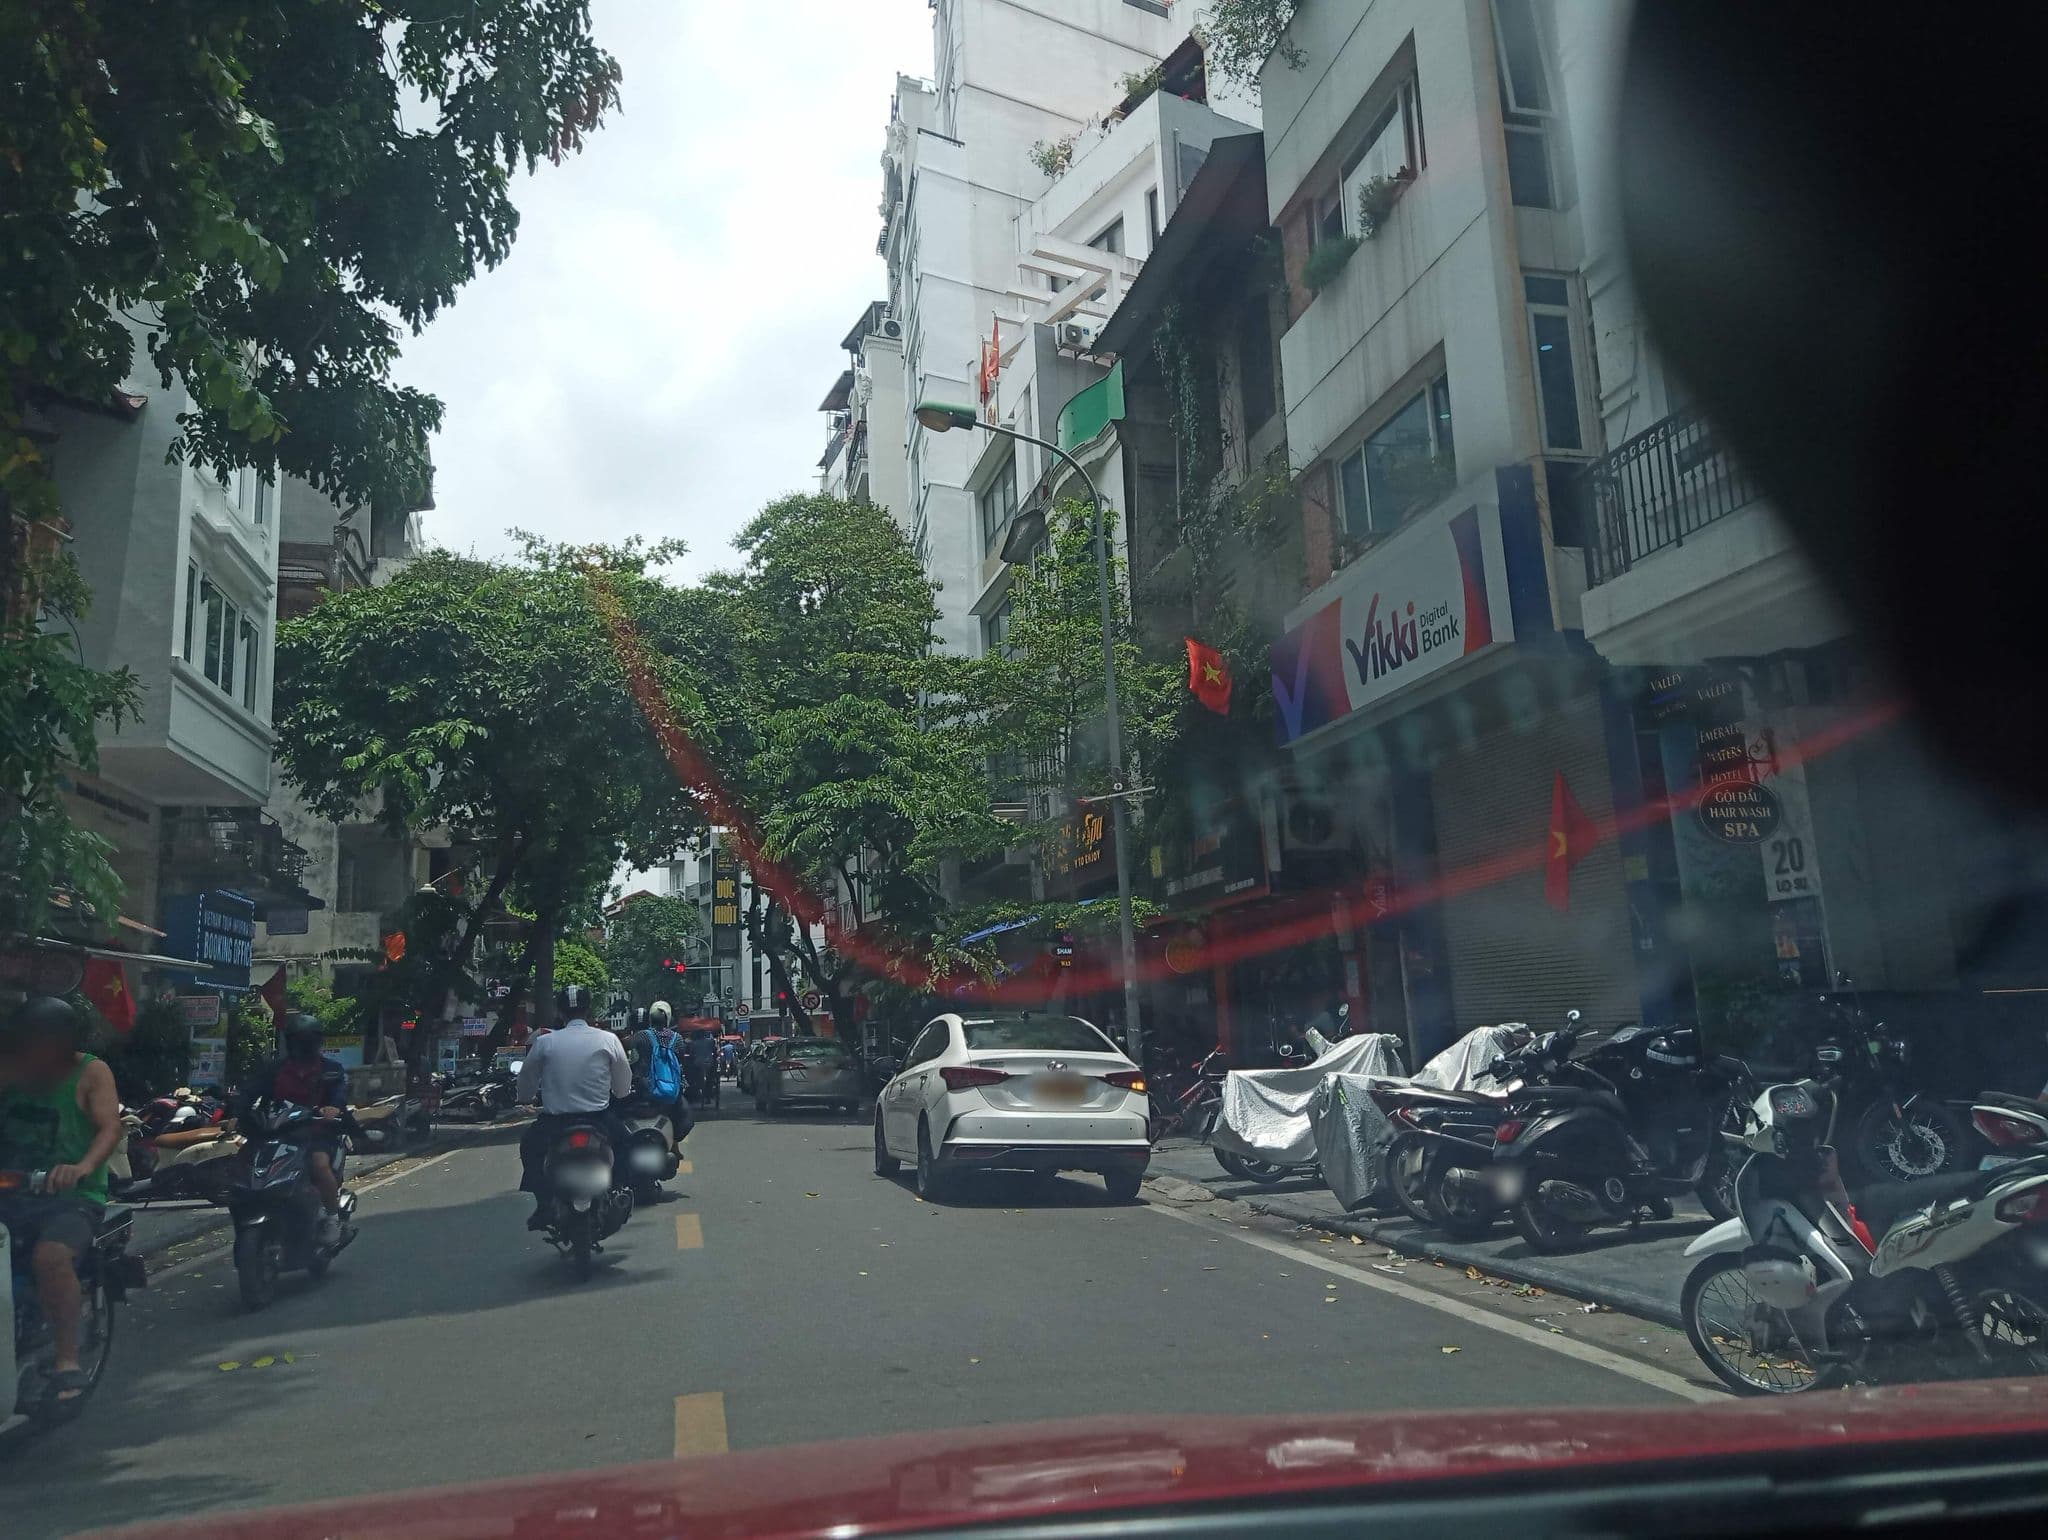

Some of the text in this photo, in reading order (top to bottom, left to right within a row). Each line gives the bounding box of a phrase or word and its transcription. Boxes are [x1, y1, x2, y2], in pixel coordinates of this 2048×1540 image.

[1420, 600, 1449, 630] Digital
[1345, 592, 1419, 685] Vikki
[1421, 615, 1460, 654] Bank
[1650, 672, 1682, 692] VALLEY
[1696, 681, 1733, 701] VALLEY
[1709, 806, 1772, 819] HAIR WASH
[1724, 821, 1761, 838] SPA
[1772, 837, 1805, 875] 20
[203, 930, 233, 964] BOOKING
